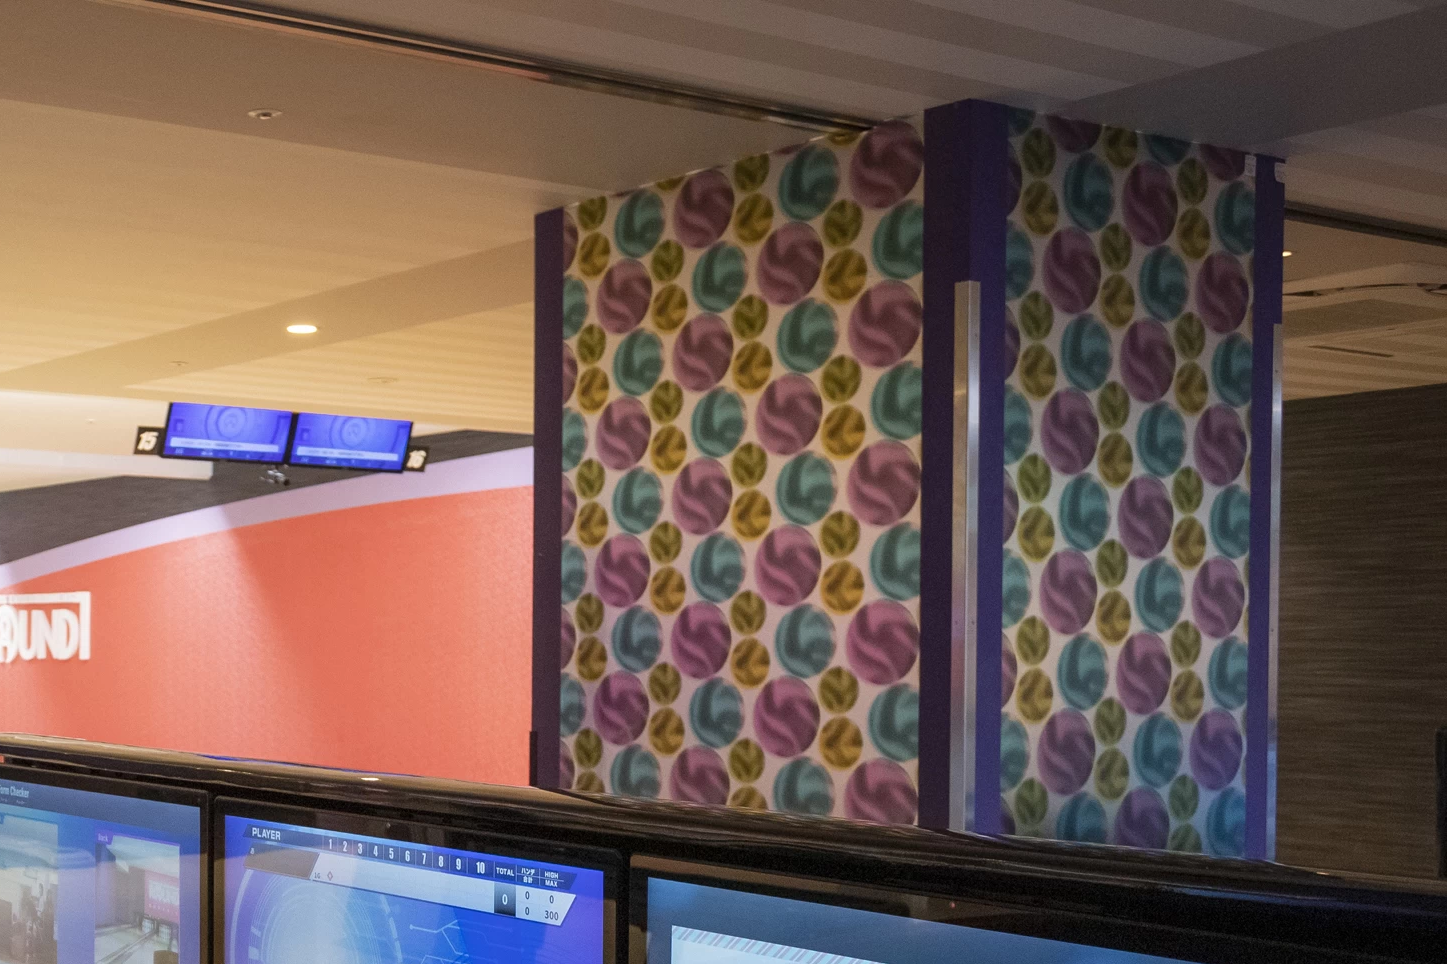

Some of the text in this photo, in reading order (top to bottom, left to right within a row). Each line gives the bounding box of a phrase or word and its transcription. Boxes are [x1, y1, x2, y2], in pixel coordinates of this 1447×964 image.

[137, 431, 158, 451] 15
[407, 450, 426, 469] 16
[10, 786, 29, 798] Checker
[252, 827, 515, 877] PLAYER 1 2 3 4 5 6 7 8 9 10 TOTAL
[521, 867, 535, 876] ハンデ
[544, 870, 559, 879] HIGH
[523, 875, 533, 884] 合計
[545, 879, 558, 888] MAX
[502, 893, 508, 906] 0
[525, 891, 554, 904] 0 0
[525, 906, 559, 921] 0 300
